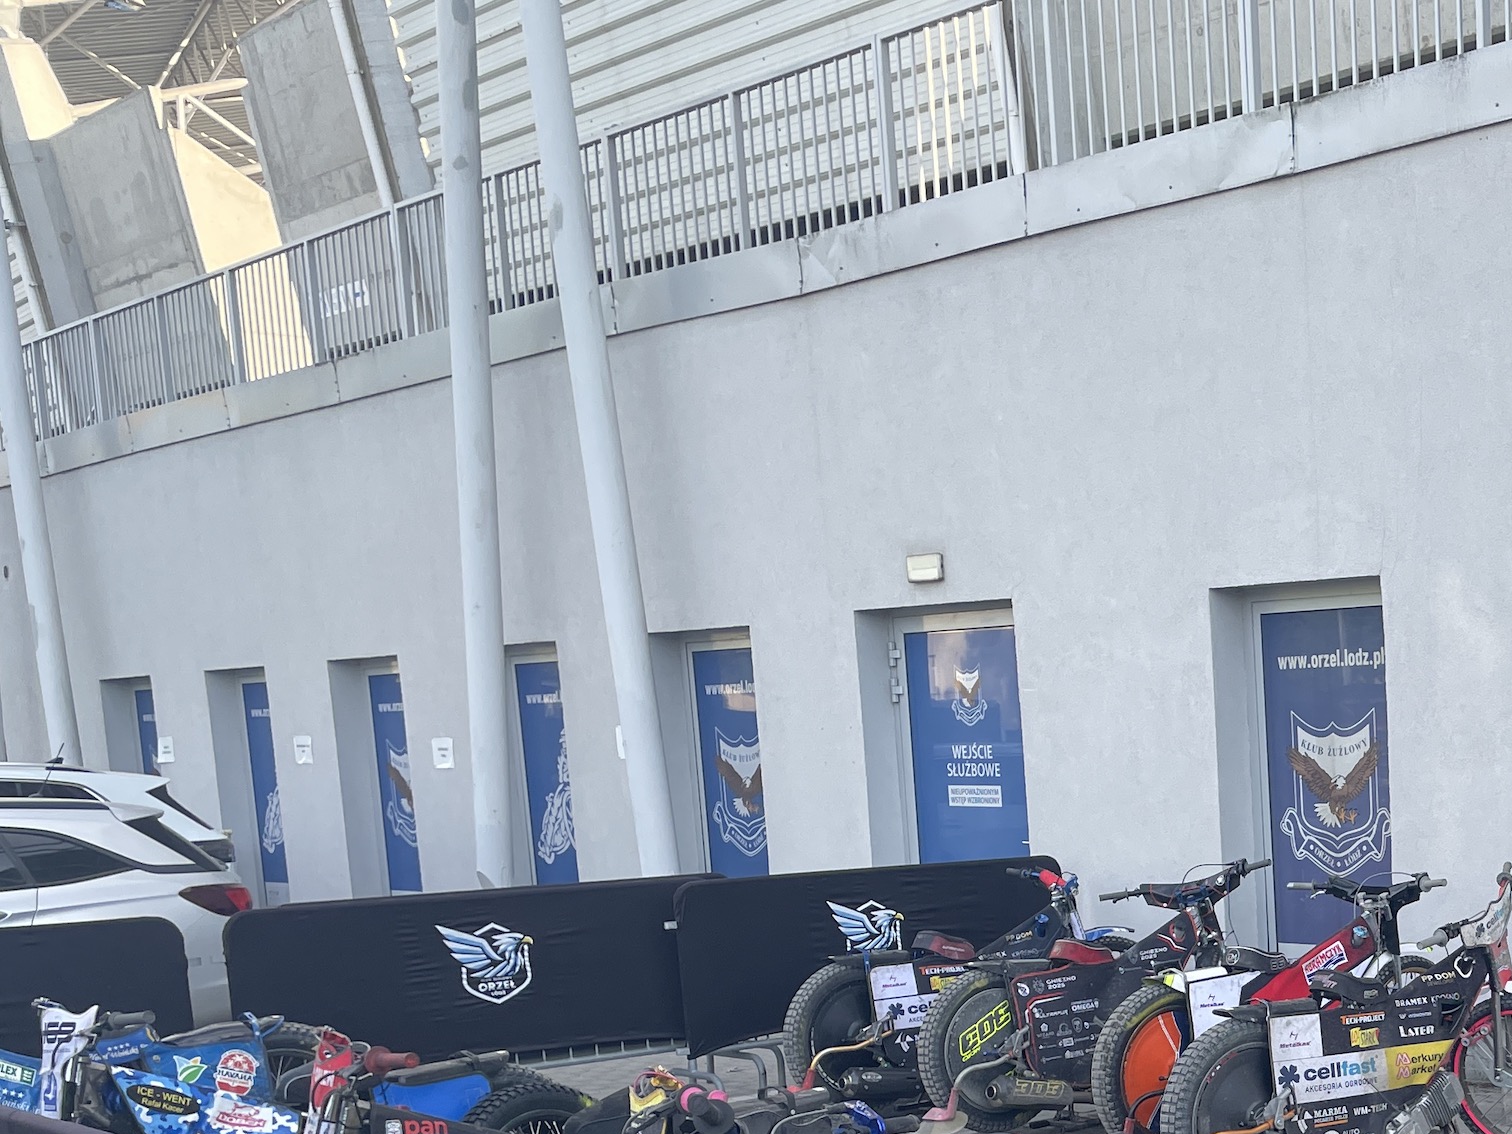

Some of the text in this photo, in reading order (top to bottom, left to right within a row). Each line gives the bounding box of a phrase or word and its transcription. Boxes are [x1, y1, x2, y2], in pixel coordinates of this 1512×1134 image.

[1278, 648, 1386, 670] www.orzel.lodz.pl
[951, 742, 993, 759] WEJŚCIE
[1301, 738, 1324, 756] KLUB
[947, 760, 1001, 777] SŁUŻBOWE
[1421, 970, 1456, 983] PP DOM
[1047, 982, 1066, 990] 2025
[1395, 996, 1428, 1007] BRAMEX
[1340, 1013, 1386, 1025] TECH-PROJECT
[1395, 1052, 1444, 1066] Merkury
[1304, 1058, 1377, 1081] cellfast
[1396, 1064, 1437, 1079] Market
[137, 1085, 155, 1098] ICE
[162, 1091, 193, 1107] WENT
[1314, 1105, 1348, 1119] MARMA
